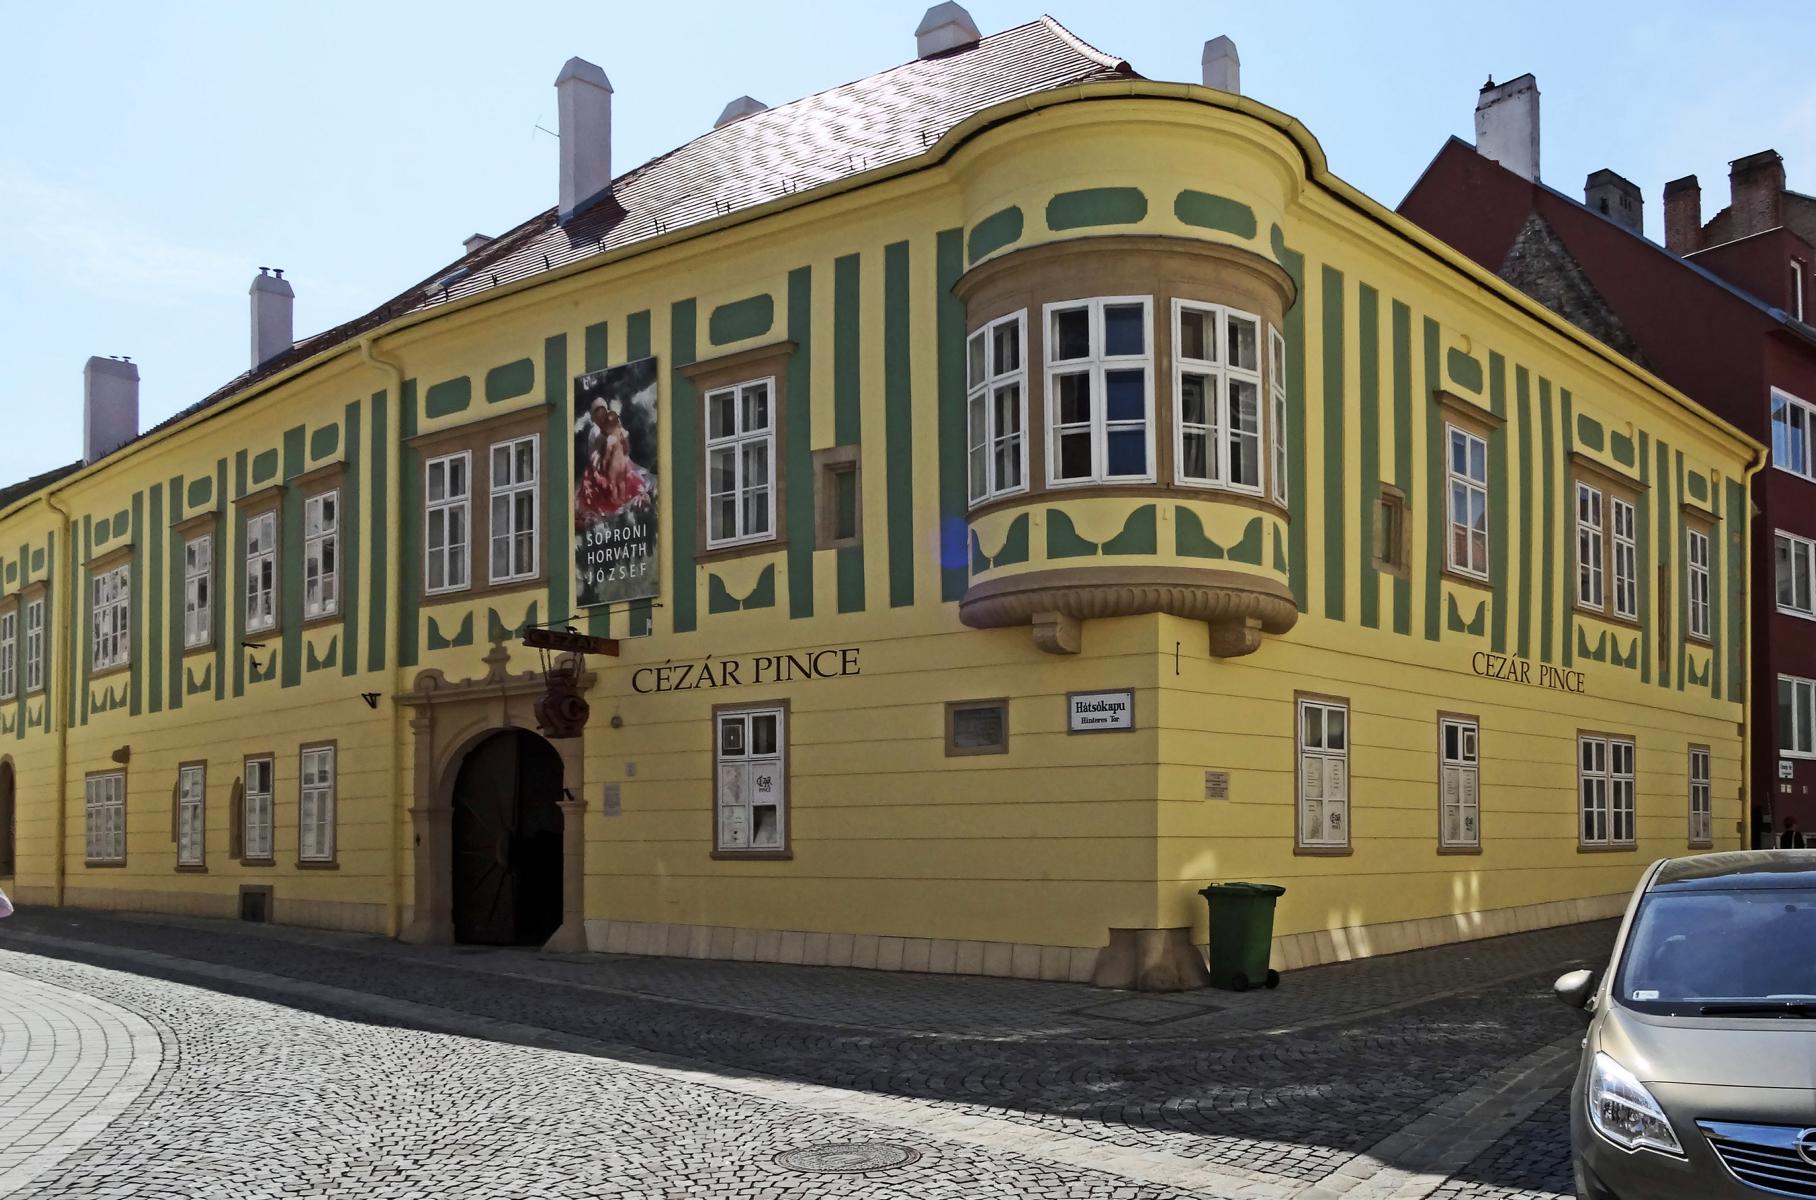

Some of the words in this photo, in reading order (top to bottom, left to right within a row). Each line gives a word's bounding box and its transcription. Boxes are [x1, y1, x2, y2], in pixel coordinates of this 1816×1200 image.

[587, 523, 647, 547] SOPRONI
[587, 542, 647, 565] HORVÁTH
[587, 562, 647, 585] JÓZSEF
[632, 654, 742, 694] CÉZÁR
[752, 648, 861, 684] PINCE
[1539, 664, 1585, 693] PINCE
[1075, 700, 1126, 714] Hátsókapu
